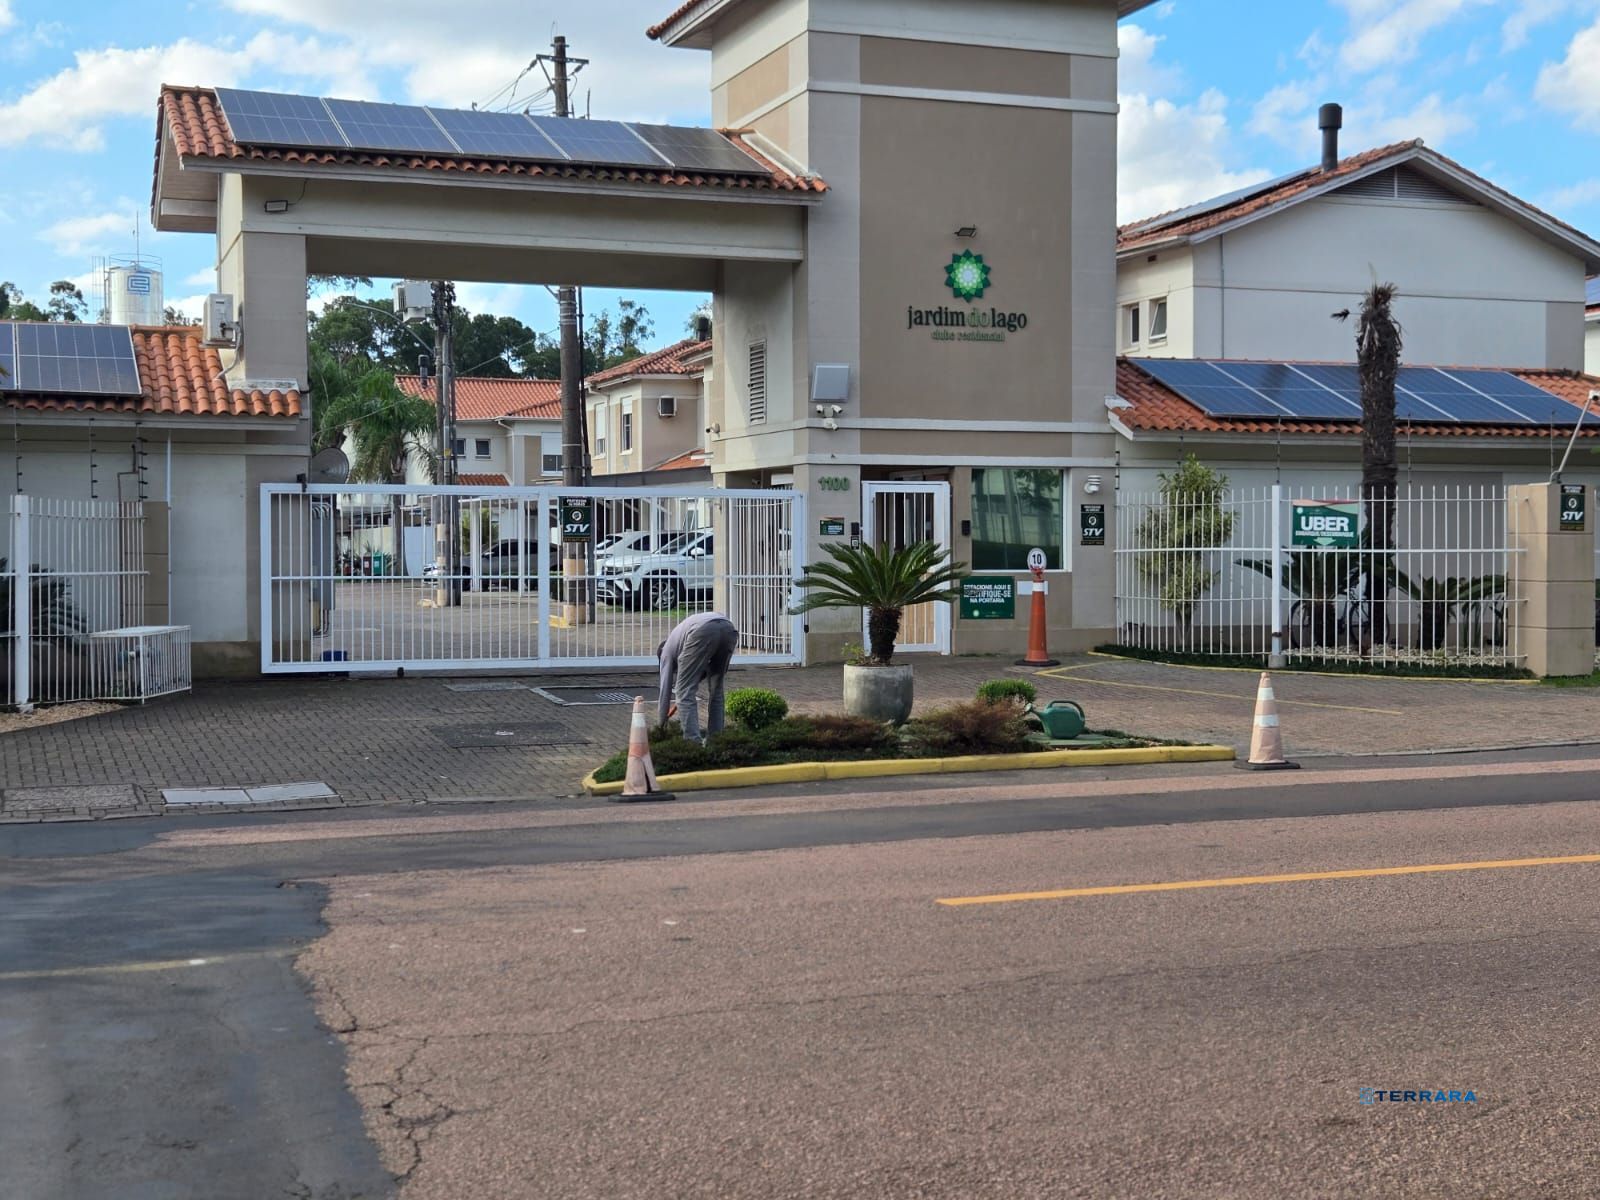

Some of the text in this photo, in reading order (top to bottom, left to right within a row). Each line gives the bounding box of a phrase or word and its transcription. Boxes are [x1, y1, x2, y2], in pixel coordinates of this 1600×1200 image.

[818, 476, 849, 491] 1100
[1561, 511, 1583, 521] STV
[563, 523, 590, 533] STV
[1300, 515, 1350, 532] UBER
[1082, 527, 1103, 537] STV
[1032, 553, 1042, 565] 10
